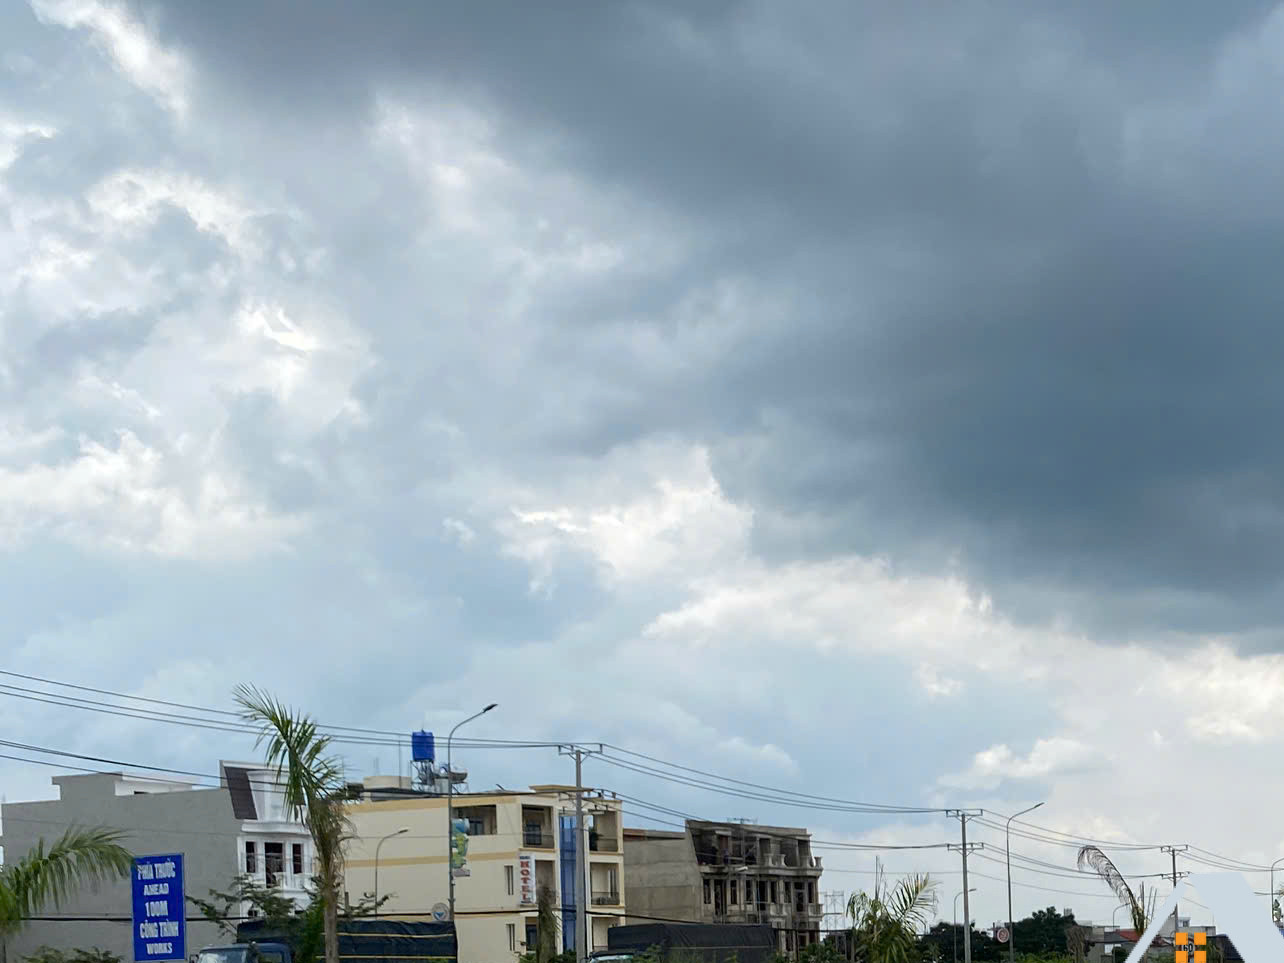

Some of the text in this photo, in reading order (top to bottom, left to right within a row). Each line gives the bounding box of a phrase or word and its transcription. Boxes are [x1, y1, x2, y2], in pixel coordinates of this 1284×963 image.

[144, 883, 169, 896] AHEAD
[520, 860, 530, 902] HOTEL
[145, 900, 168, 917] 100M
[140, 920, 159, 939] CÔNG
[146, 942, 173, 955] WORKS
